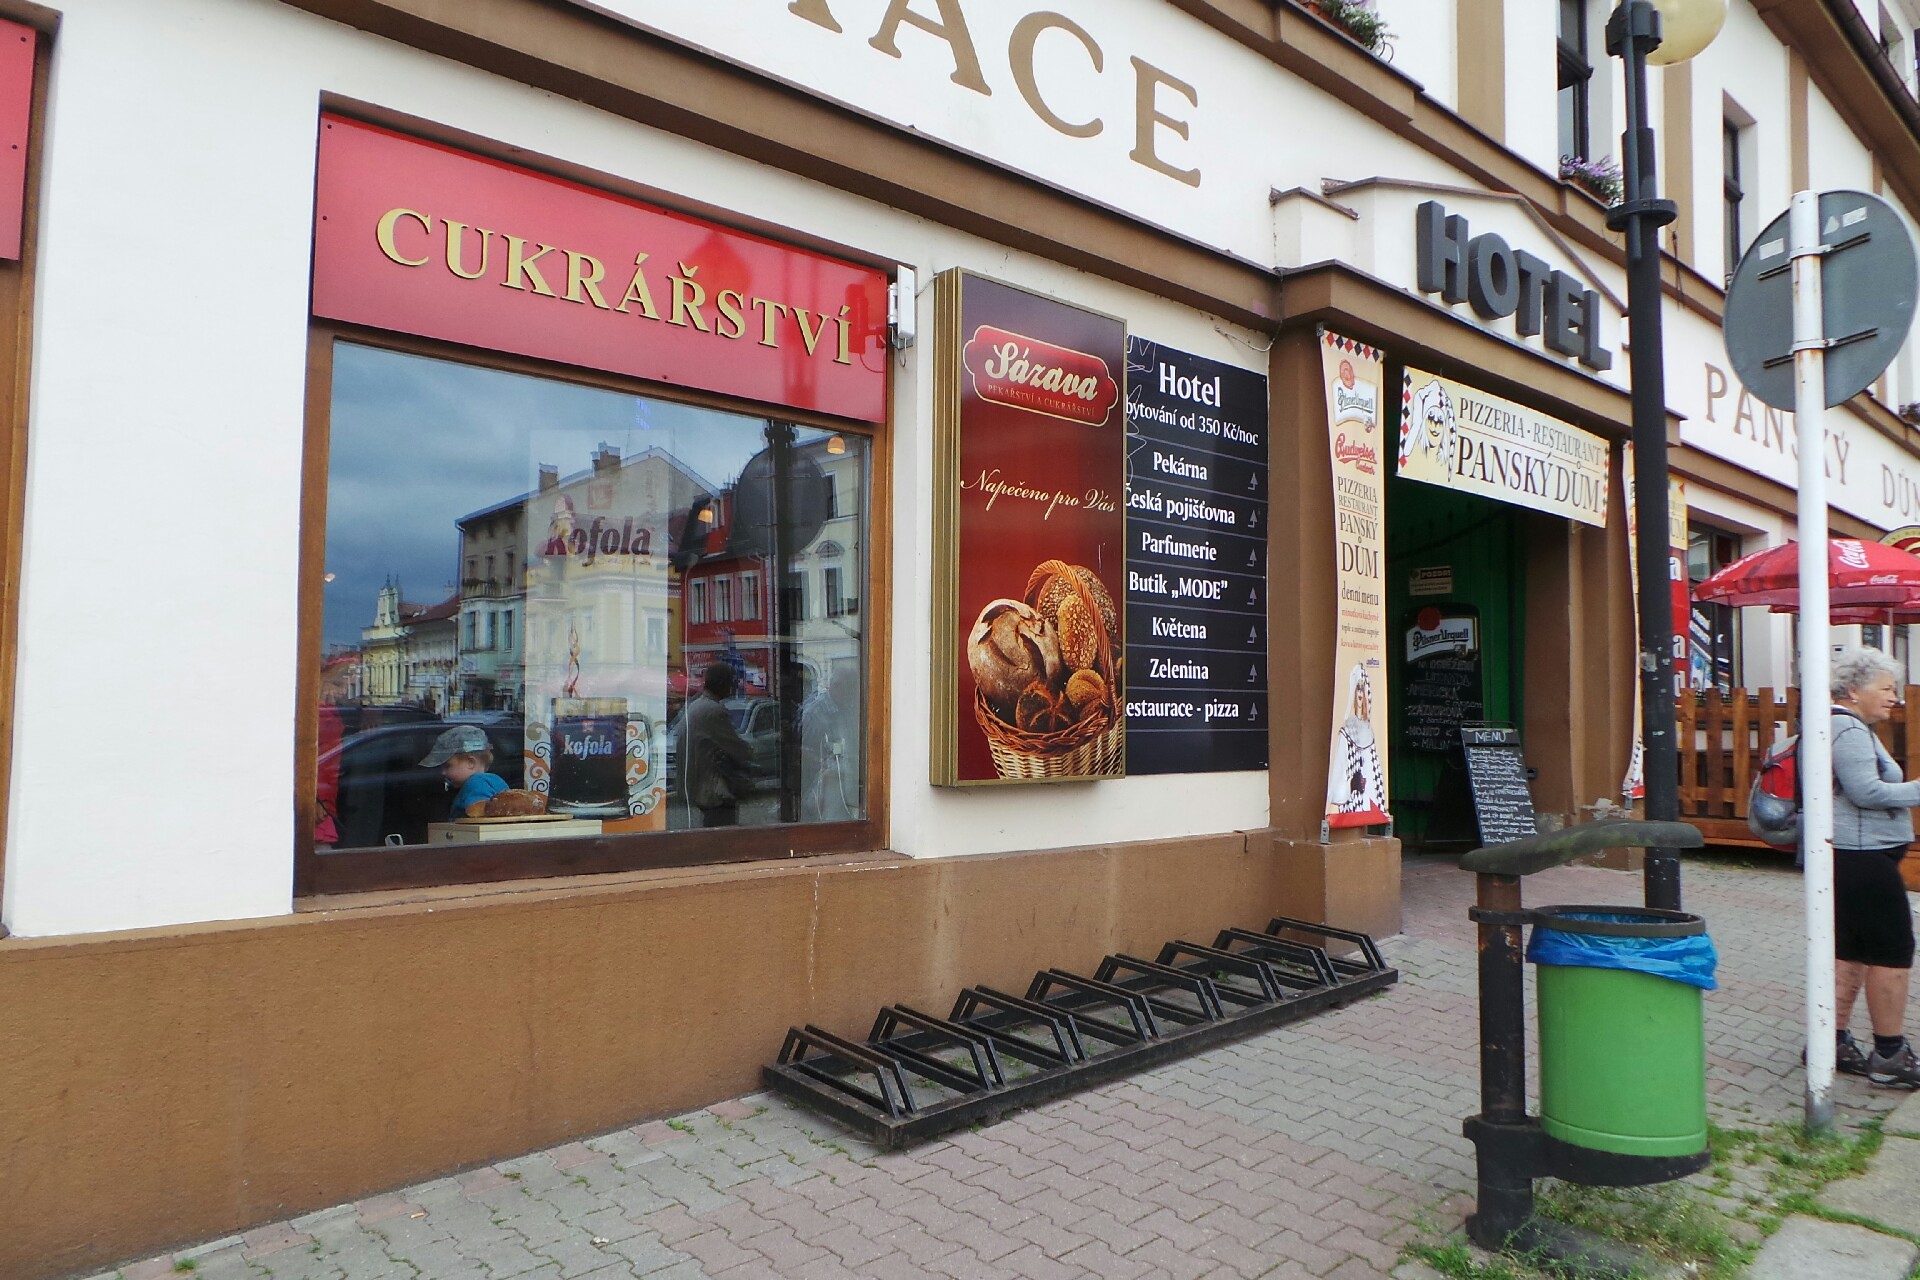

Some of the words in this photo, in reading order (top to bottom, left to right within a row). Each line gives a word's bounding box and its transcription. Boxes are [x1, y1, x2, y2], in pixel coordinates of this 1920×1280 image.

[788, 0, 1201, 188] ACE
[375, 206, 853, 366] CUKRÁŘSTVÍ
[1417, 200, 1612, 371] HOTEL
[985, 341, 1098, 401] Sázava
[1159, 362, 1221, 408] Hotel
[988, 384, 1034, 405] PEKAŘSTVÍ
[1044, 397, 1096, 417] CUKRÁŘSTVÍ
[1126, 394, 1178, 426] bytování
[1180, 413, 1196, 431] od
[1199, 415, 1221, 437] 350
[1223, 422, 1260, 446] Kč/noc
[1459, 397, 1525, 439] PIZZERIA
[1532, 422, 1600, 467] RESTAURANT
[1335, 432, 1377, 462] Budweiser
[1153, 451, 1208, 481] Pekárna
[1456, 434, 1553, 497] PANSKÝ
[1554, 460, 1600, 513] DŮM
[960, 468, 1051, 511] Napečeno
[1044, 490, 1081, 520] pro
[1082, 488, 1116, 512] Vás
[1337, 476, 1378, 504] PIZZERIA
[1338, 494, 1378, 516] RESTAURANT
[1166, 498, 1236, 525] pojišťovna
[1339, 511, 1379, 541] PANSKÝ
[1142, 531, 1218, 561] Parfumerie
[1340, 535, 1379, 579] DŮM
[1129, 571, 1168, 594] Butik
[1341, 580, 1361, 603] denní
[1361, 591, 1379, 606] menu
[1152, 616, 1207, 640] Květena
[1413, 630, 1441, 652] Pilsner
[1440, 628, 1469, 643] Urquell
[1149, 658, 1209, 680] Zelenina
[1124, 700, 1194, 718] estaurace
[1204, 698, 1239, 723] pizza
[563, 724, 612, 761] kofola
[1475, 731, 1507, 744] MENU
